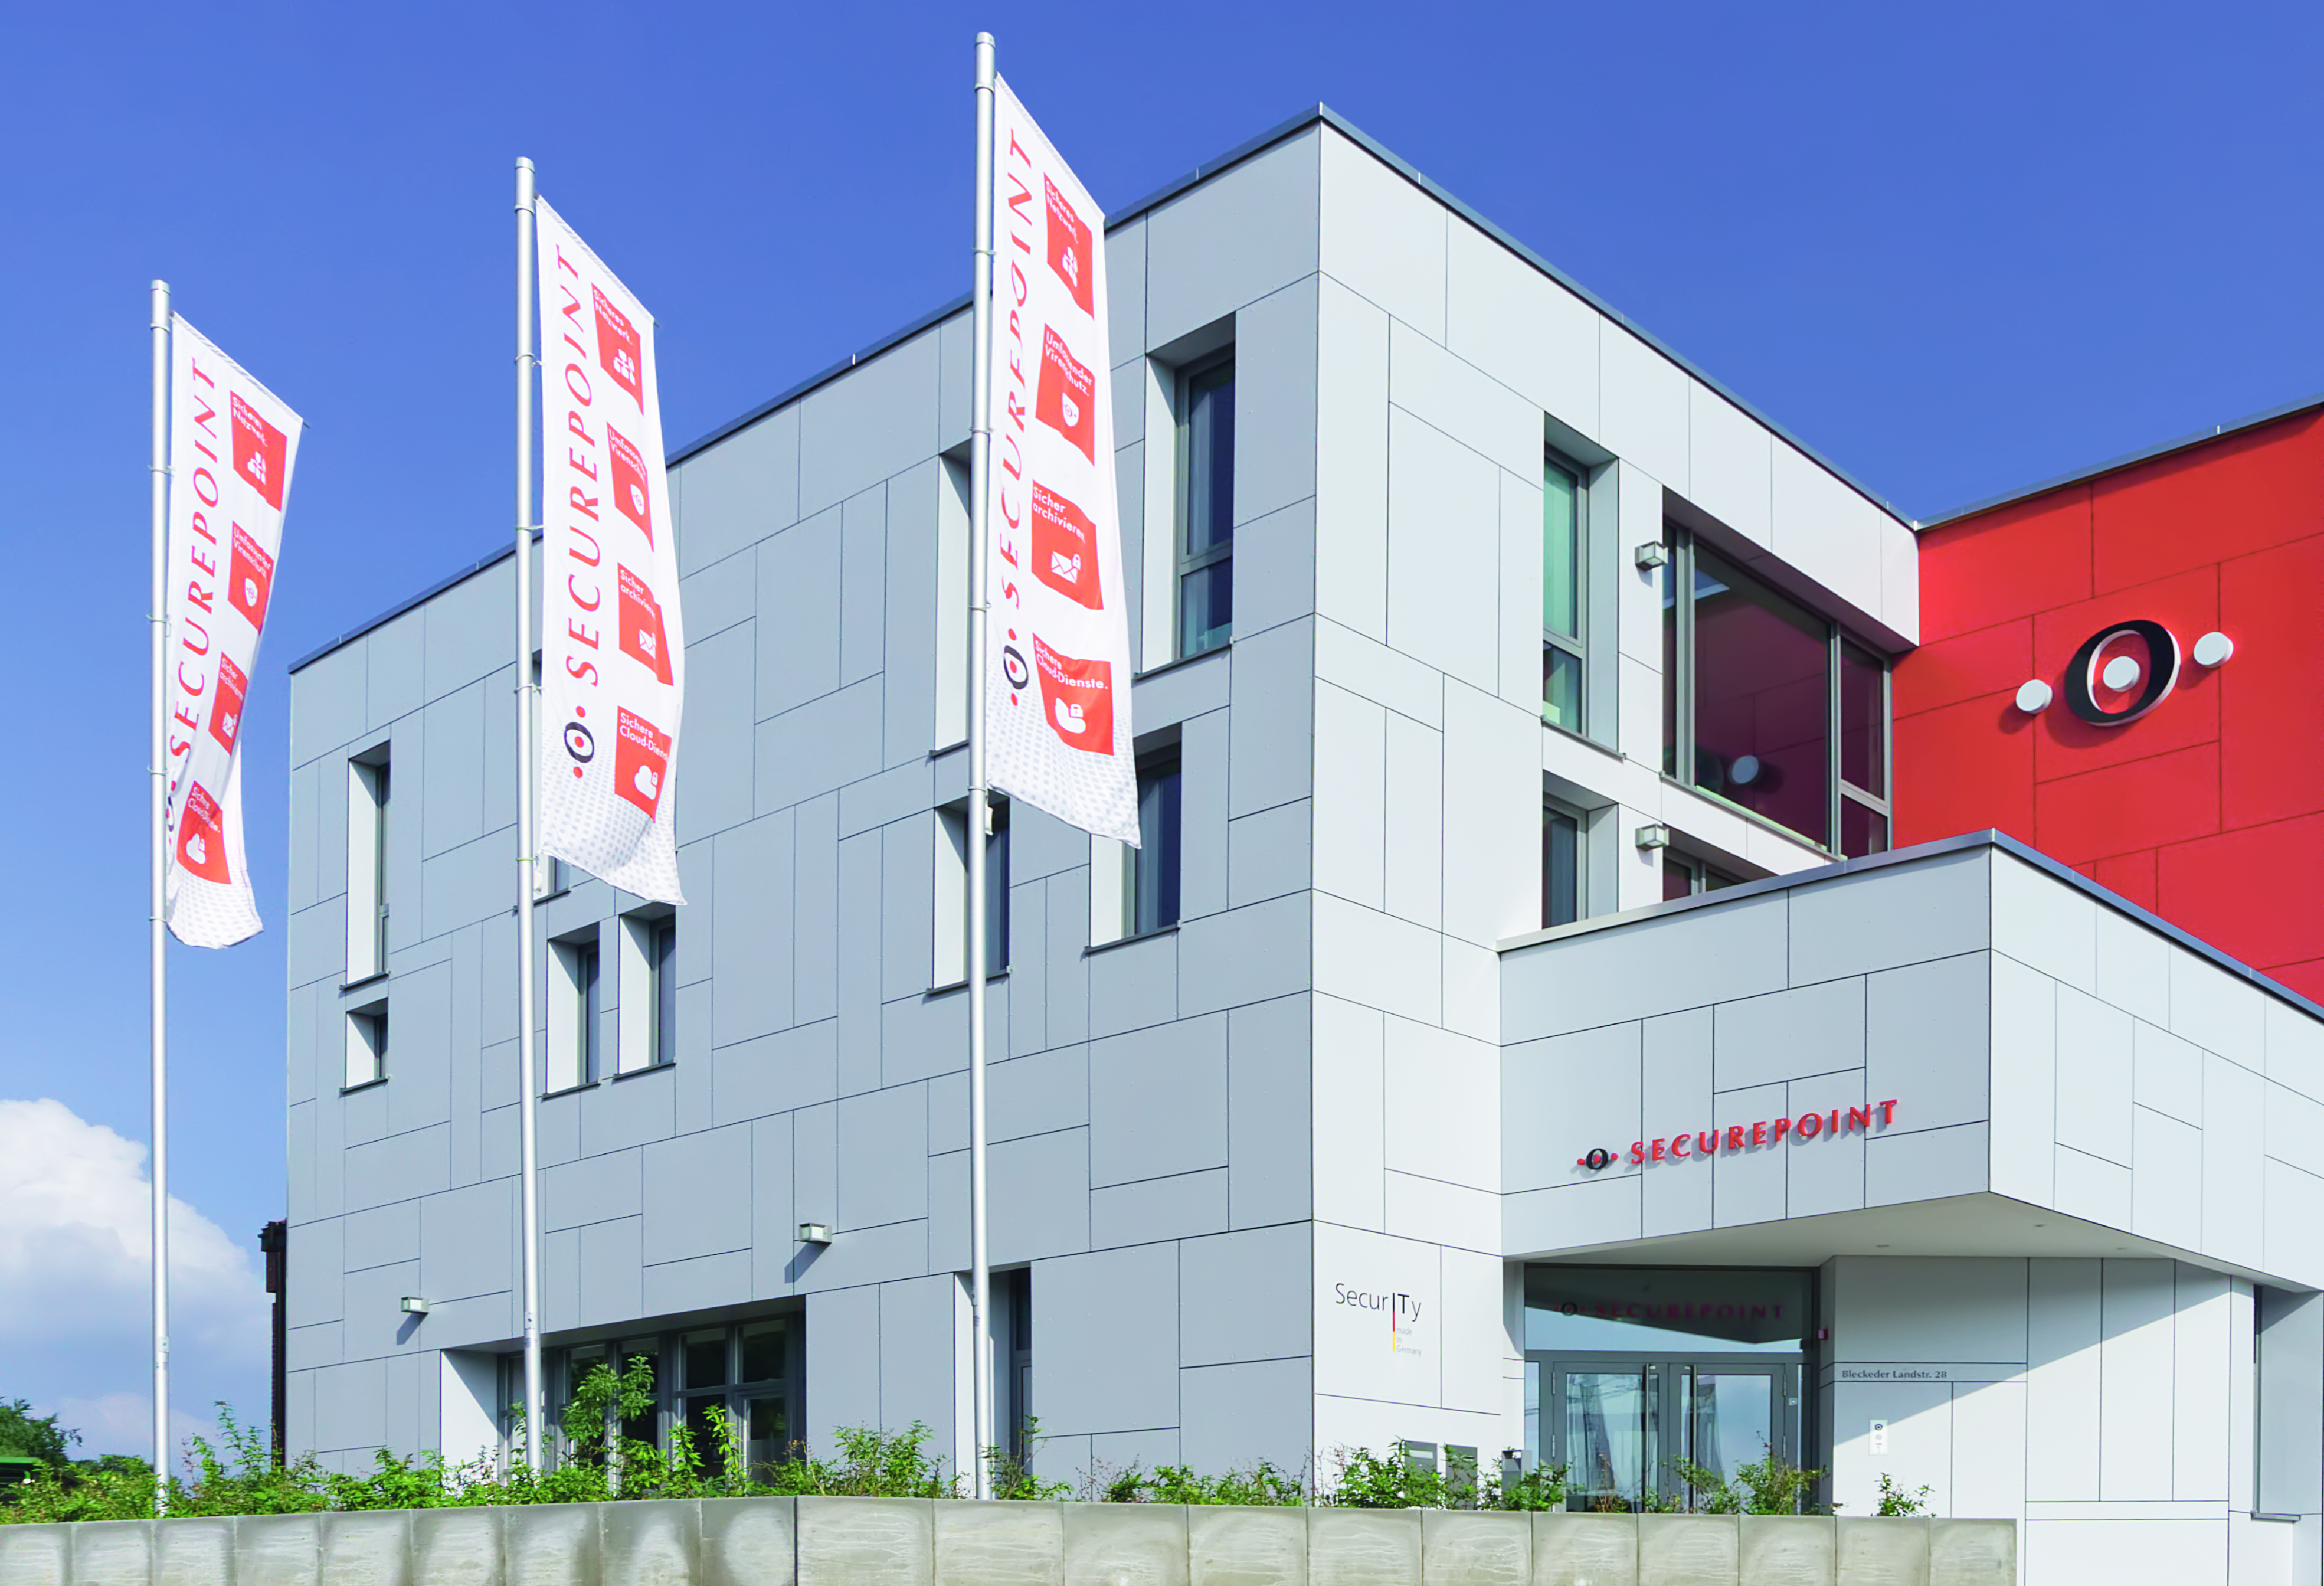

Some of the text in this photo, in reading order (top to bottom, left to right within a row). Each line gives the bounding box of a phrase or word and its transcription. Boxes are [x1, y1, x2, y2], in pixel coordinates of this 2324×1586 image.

[555, 244, 601, 687] SECUREPOINT
[1033, 486, 1066, 513] Sicher
[1033, 502, 1086, 544] archivieren.
[169, 357, 219, 757] SECUREPOINT
[620, 568, 644, 594] Sicher
[1035, 639, 1062, 671] Sichere
[1036, 653, 1108, 690] Cloud-Dienste.
[620, 712, 654, 739] Sichere
[1631, 1099, 1898, 1165] SECUREPOINT
[1336, 1283, 1422, 1322] SecurITy
[1396, 1327, 1413, 1336] made
[1396, 1345, 1422, 1358] Germany
[1842, 1369, 1890, 1378] Bleckeder
[1893, 1370, 1932, 1379] Landstr.
